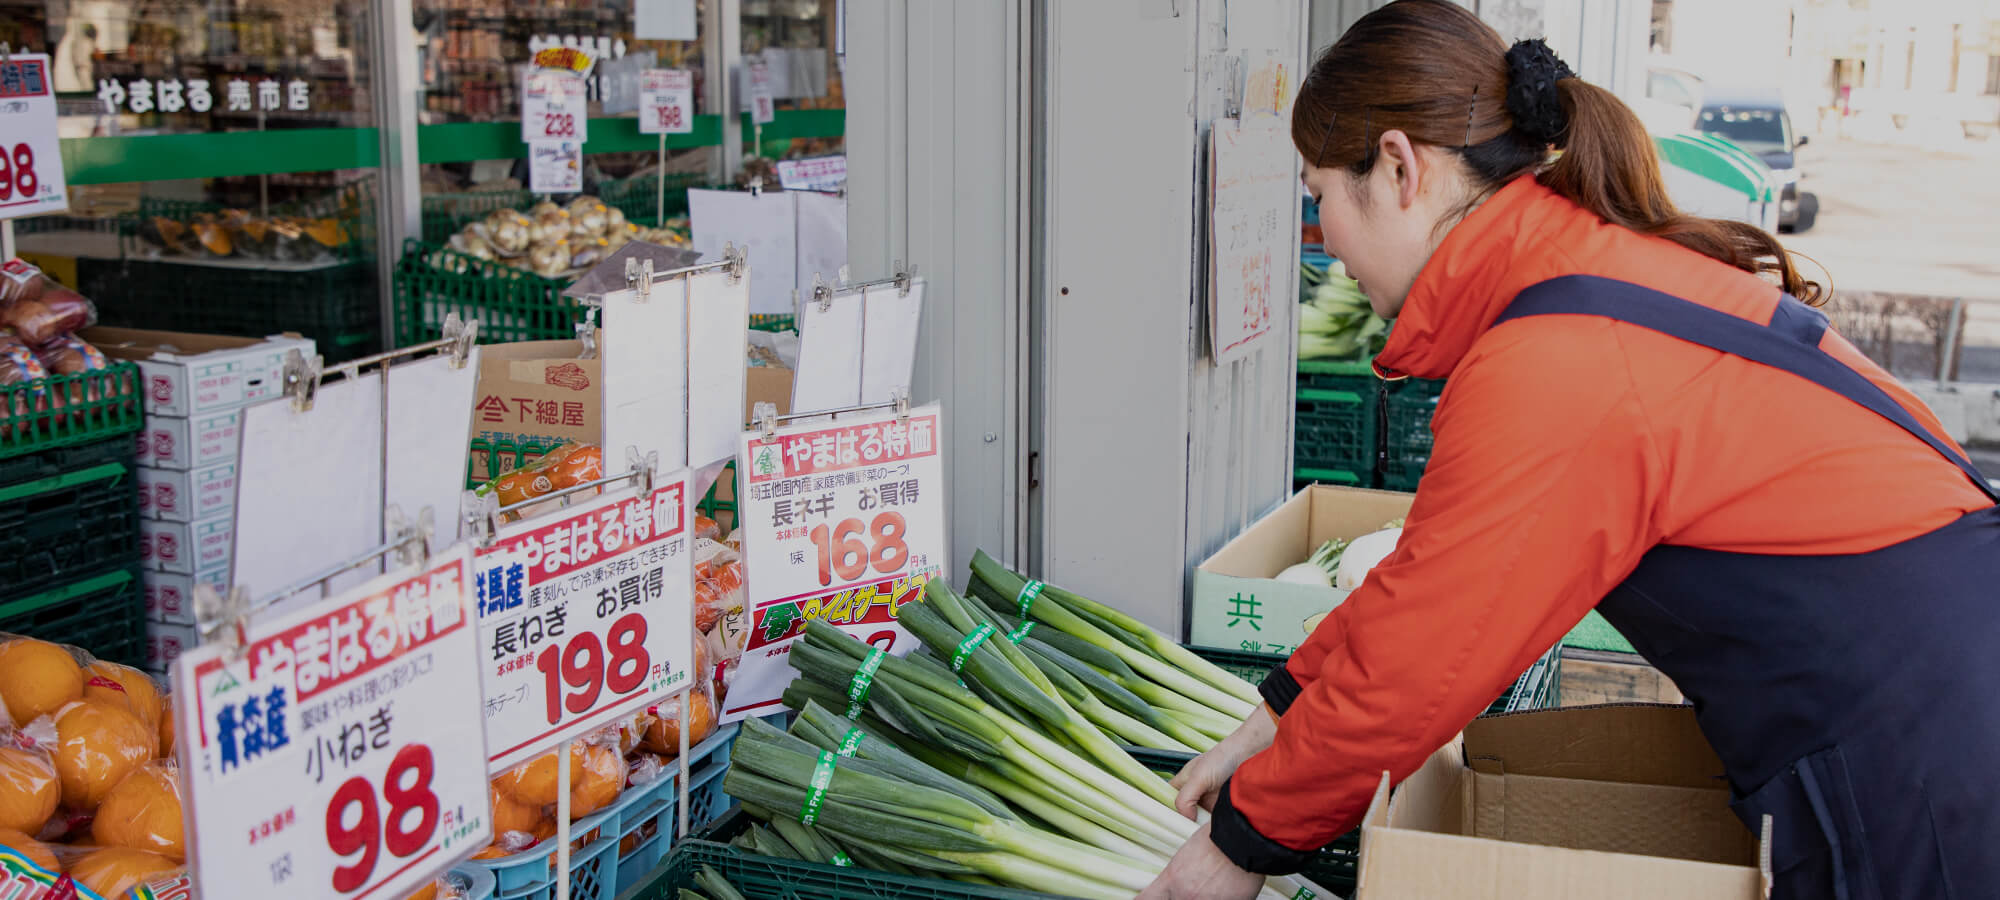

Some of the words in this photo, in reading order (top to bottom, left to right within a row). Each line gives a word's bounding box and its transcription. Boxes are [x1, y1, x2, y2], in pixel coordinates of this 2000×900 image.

[98, 78, 213, 113] やまはる
[545, 112, 575, 136] 238
[787, 420, 932, 472] やまはる特価
[515, 487, 680, 573] やまはる特価
[771, 491, 835, 527] 長ネギ
[858, 479, 920, 511] お買得
[775, 525, 808, 541] 本体価格
[809, 511, 909, 587] 168
[253, 567, 461, 694] やまはる特価
[491, 600, 569, 660] 長ねぎ
[597, 566, 664, 619] お買得
[1226, 591, 1263, 632] 共
[496, 651, 535, 677] 本体価格
[537, 612, 651, 726] 198
[216, 684, 290, 775] 青森産
[306, 700, 394, 784] 小ねぎ
[248, 805, 295, 846] 本体価格
[326, 742, 441, 893] 98
